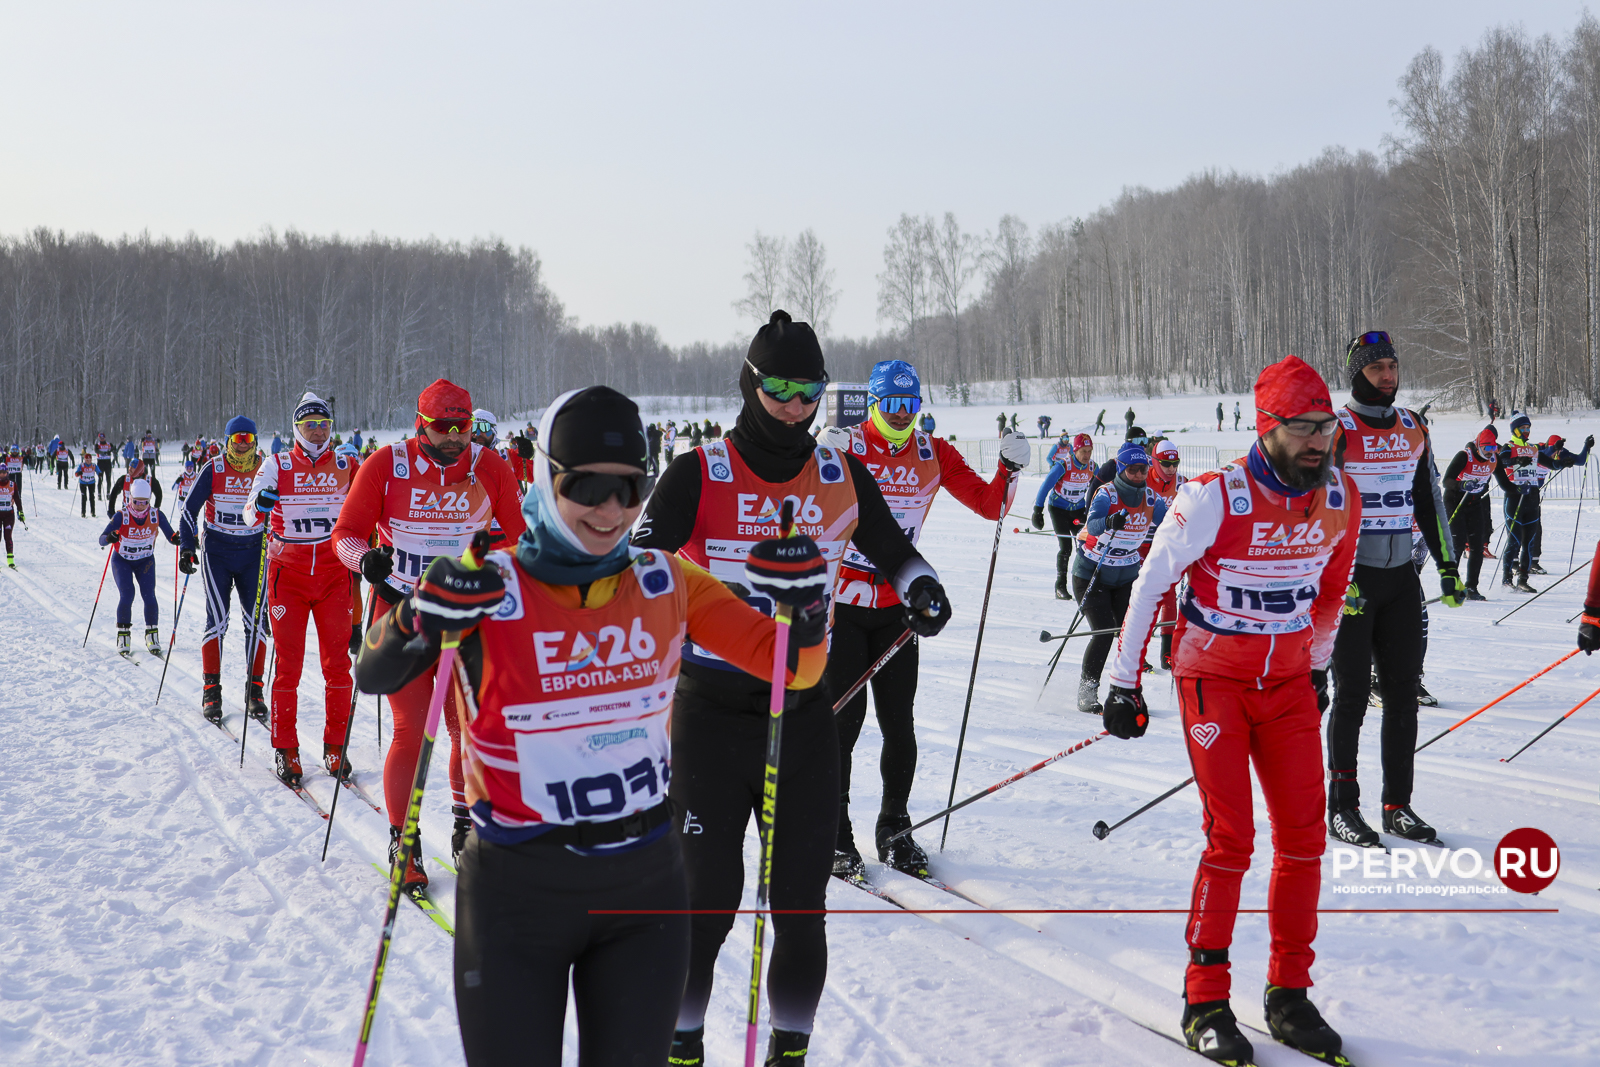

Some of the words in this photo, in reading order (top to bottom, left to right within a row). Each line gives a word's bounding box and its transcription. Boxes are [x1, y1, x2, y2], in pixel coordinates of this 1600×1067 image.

[843, 409, 865, 417] СТАРТ
[1362, 433, 1410, 453] ЕА26
[1364, 451, 1413, 460] ЕВРОПА-АЗИЯ
[225, 476, 253, 489] ЕА2
[294, 472, 338, 488] ЕА26
[880, 484, 920, 494] ОПА-АЗИЯ
[409, 487, 471, 512] ЕА26
[737, 493, 823, 524] ЕА26
[408, 510, 471, 519] ЕВРОПА-АЗИЯ
[1250, 519, 1325, 547] ЕА26
[776, 546, 808, 557] MOAX
[444, 574, 481, 589] MOAX
[532, 616, 656, 675] ЕА26
[540, 659, 661, 693] ЕВРОПА-АЗИЯ
[761, 763, 778, 825] LEKI
[403, 787, 424, 847] LEKI
